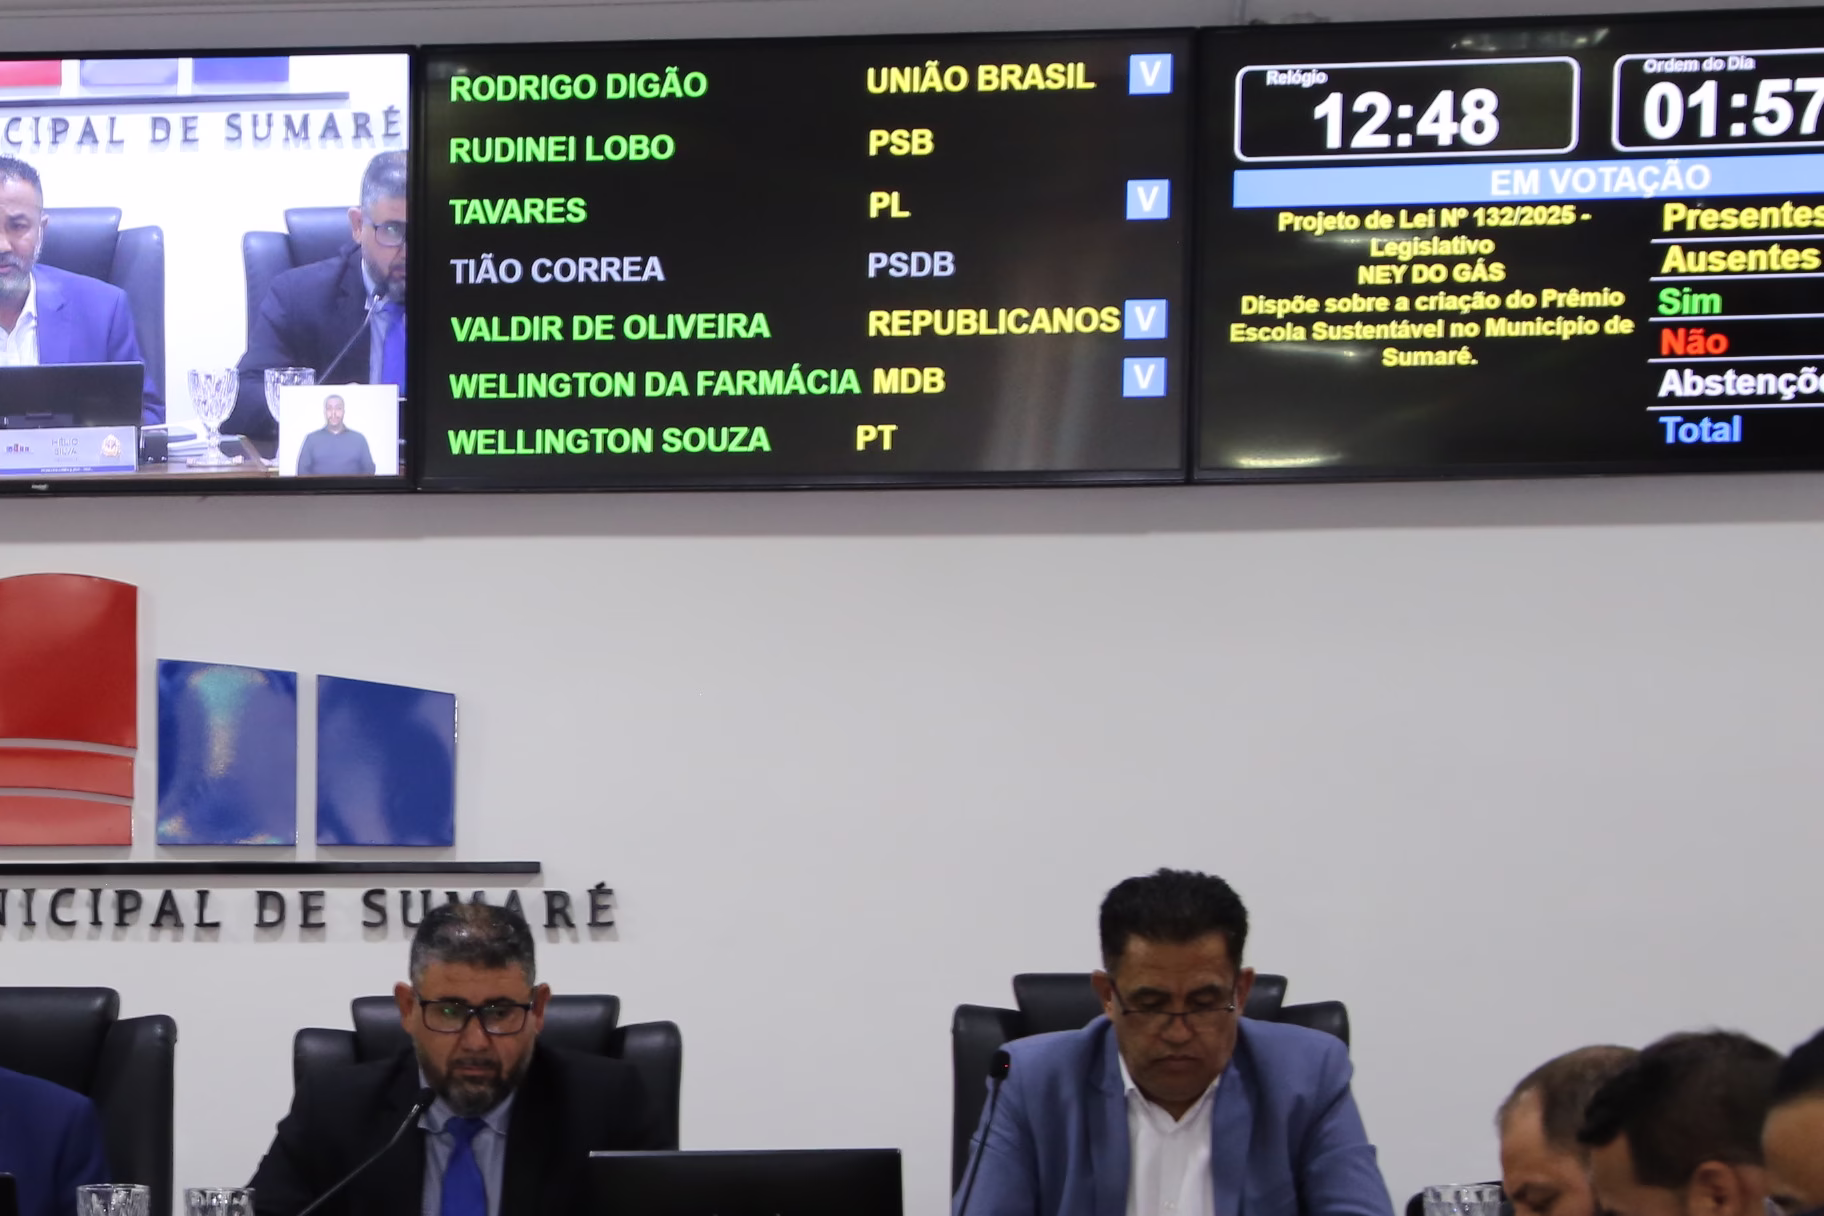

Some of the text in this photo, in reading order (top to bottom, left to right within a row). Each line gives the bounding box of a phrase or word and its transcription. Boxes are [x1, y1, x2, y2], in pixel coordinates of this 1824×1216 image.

[868, 60, 1096, 94] UNIÃO BRASIL
[1140, 61, 1161, 86] V
[1266, 68, 1329, 86] Relógio
[1643, 55, 1756, 73] Ordem do Dia
[451, 66, 707, 102] RODRIGO DIGÃO
[1313, 89, 1500, 149] 12:48
[1643, 78, 1824, 139] 01:57
[151, 116, 199, 143] DE
[225, 105, 401, 142] SUMARÉ
[450, 134, 674, 163] RUDINEI LOBO
[869, 129, 934, 156] PSB
[1491, 161, 1711, 198] EM VOTAÇÃO
[449, 198, 587, 224] TAVARES
[870, 192, 911, 218] PL
[1138, 186, 1158, 211] V
[1278, 213, 1360, 234] Projeto
[1364, 210, 1394, 230] de
[1400, 209, 1434, 229] Lei
[1473, 205, 1576, 227] 132/2025
[1370, 236, 1495, 262] Legislativo
[1661, 244, 1822, 273] Ausentes
[450, 253, 665, 283] TIÃO CORREA
[869, 252, 954, 277] PSDB
[1358, 258, 1506, 285] NEY DO GÁS
[1242, 288, 1625, 318] Dispõe sobre a criação do Prêmio
[1658, 287, 1722, 315] Sim
[451, 313, 771, 342] VALDIR DE OLIVEIRA
[868, 306, 1121, 337] REPUBLICANOS
[1135, 306, 1156, 331] V
[1230, 315, 1635, 342] Escola Sustentável no Município de
[1661, 327, 1728, 355] Não
[1382, 346, 1479, 367] Sumaré.
[449, 363, 861, 399] WELINGTON DA FARMÁCIA
[874, 367, 946, 394] MDB
[1134, 364, 1154, 388] V
[1658, 366, 1824, 400] Abstençõ
[448, 427, 771, 455] WELLINGTON SOUZA
[857, 425, 898, 450] PT
[1659, 414, 1742, 443] Total
[255, 890, 327, 928] DE
